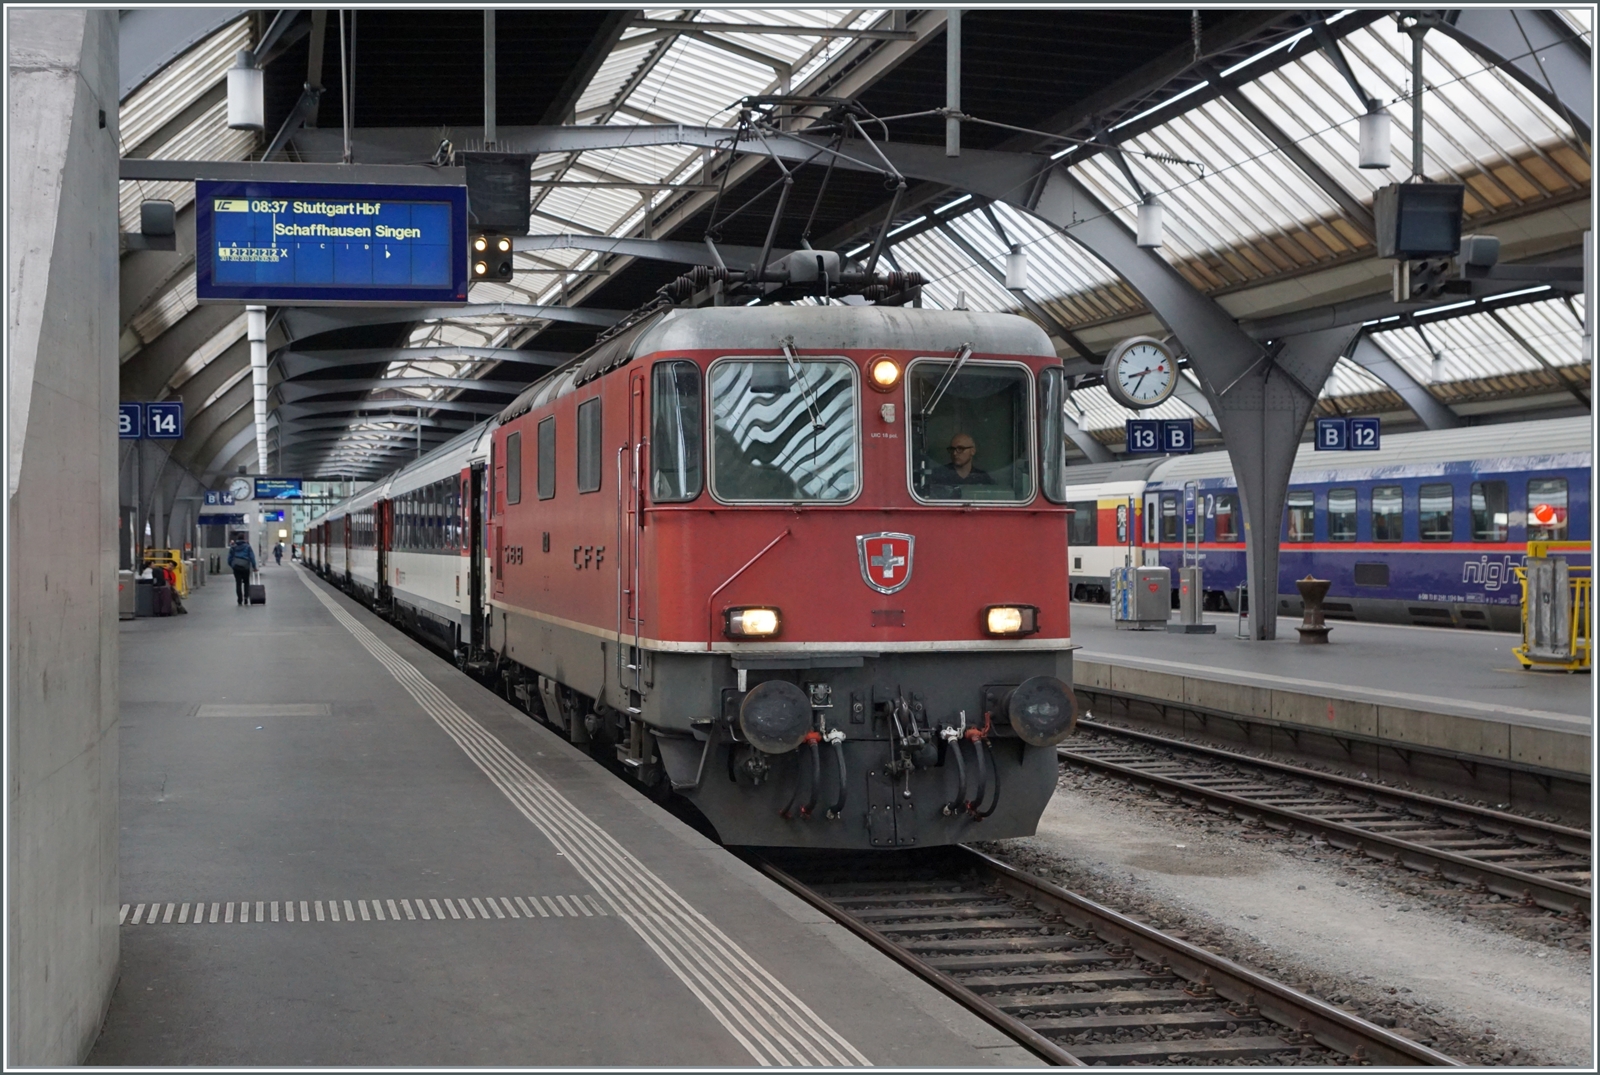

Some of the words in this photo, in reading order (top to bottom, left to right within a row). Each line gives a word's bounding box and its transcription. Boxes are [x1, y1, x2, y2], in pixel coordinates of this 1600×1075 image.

[217, 201, 232, 210] IC
[251, 200, 288, 213] 08:37
[293, 201, 355, 217] Stuttgart
[356, 203, 380, 215] Hbf
[275, 223, 371, 237] Schaffhausen
[375, 225, 421, 240] Singen
[152, 413, 176, 433] 14
[1134, 429, 1154, 447] 13
[1171, 429, 1185, 447] B
[1325, 428, 1338, 445] B
[1355, 428, 1374, 445] 12
[208, 495, 215, 503] B
[223, 495, 232, 503] 14
[1206, 493, 1214, 519] 2
[573, 545, 605, 570] CFF
